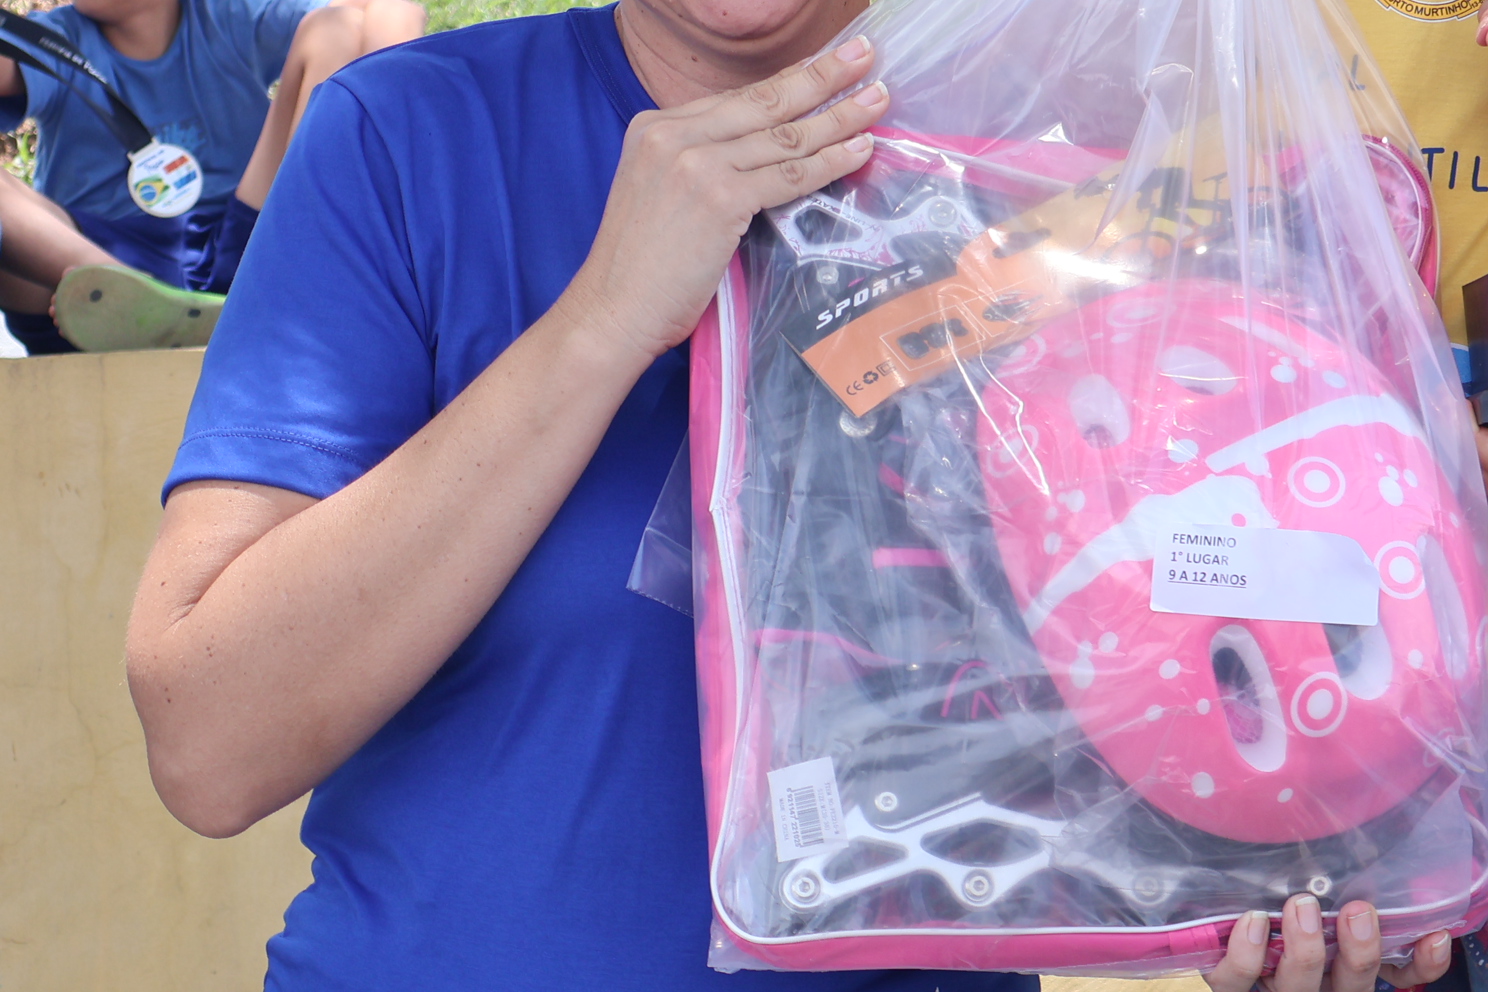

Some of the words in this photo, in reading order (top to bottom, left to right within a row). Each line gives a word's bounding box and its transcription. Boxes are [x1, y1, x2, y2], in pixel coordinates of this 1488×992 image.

[816, 265, 924, 330] SPORTS
[1172, 533, 1237, 548] FEMININO
[1186, 552, 1229, 566] LUGAR
[1168, 569, 1176, 580] 9
[1179, 570, 1188, 581] A
[1192, 571, 1207, 583] 12
[1209, 572, 1247, 586] ANOS
